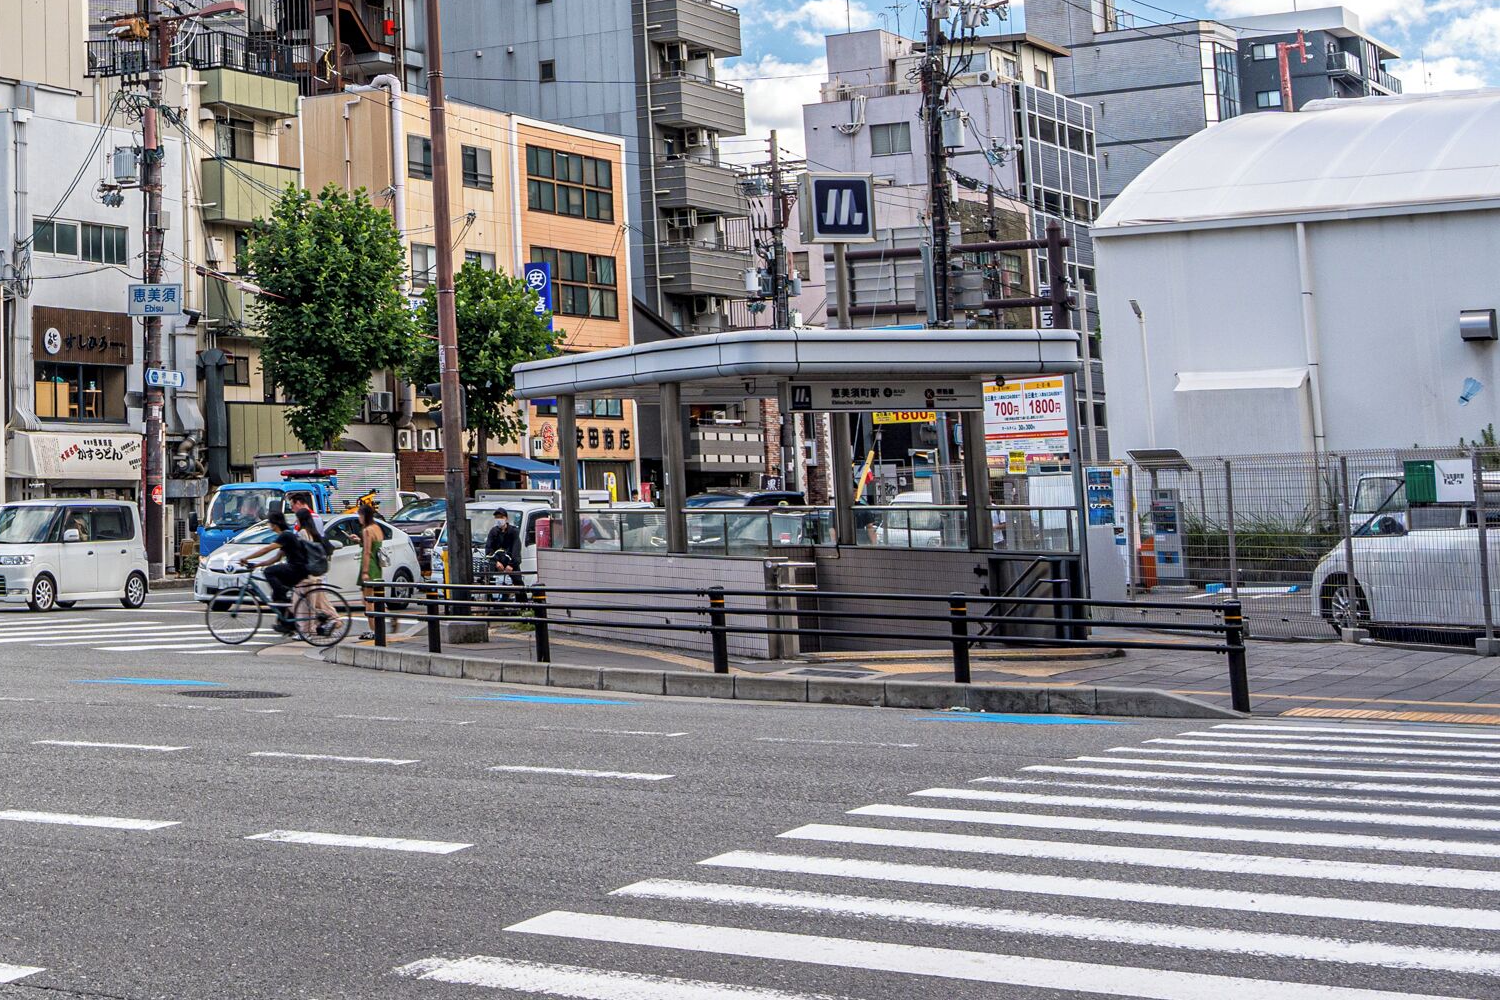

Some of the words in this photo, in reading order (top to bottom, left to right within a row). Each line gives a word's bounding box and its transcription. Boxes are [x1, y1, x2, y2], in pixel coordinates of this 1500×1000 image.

[529, 271, 544, 287] 安
[133, 287, 177, 304] 恵美須
[144, 304, 164, 314] Ebisu
[994, 401, 1019, 416] 700円
[1028, 399, 1061, 414] 1800円
[78, 447, 123, 461] かすうどん
